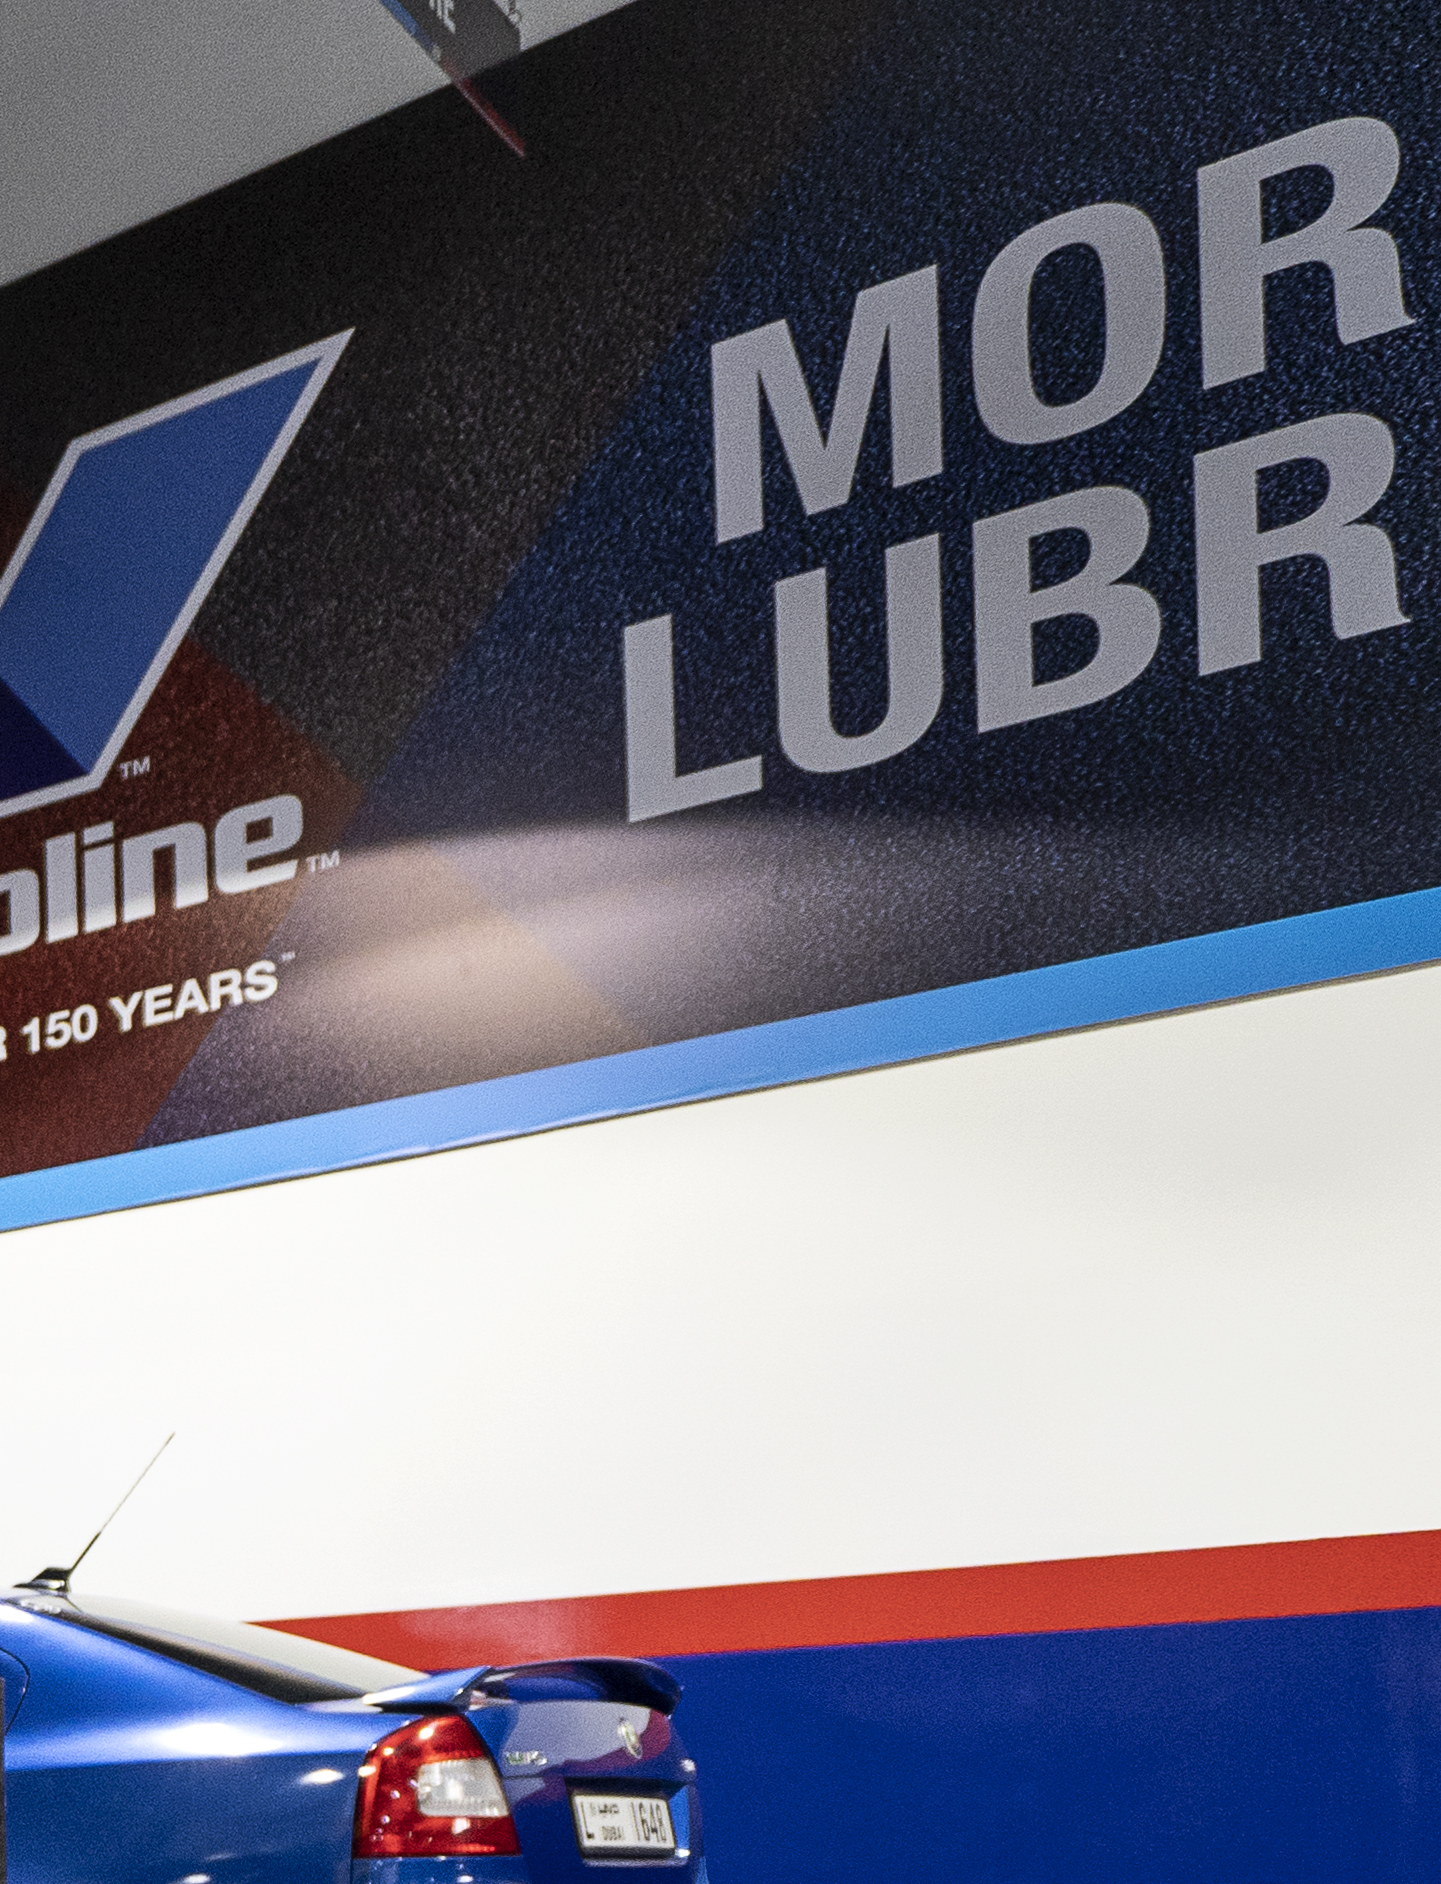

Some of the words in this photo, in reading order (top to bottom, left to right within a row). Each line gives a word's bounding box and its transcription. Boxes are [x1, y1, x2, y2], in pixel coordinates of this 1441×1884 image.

[710, 115, 1418, 546] MOR
[623, 411, 1413, 825] LUBR
[21, 1004, 98, 1054] 150
[109, 959, 279, 1033] YEARS
[630, 1801, 667, 1842] 1648
